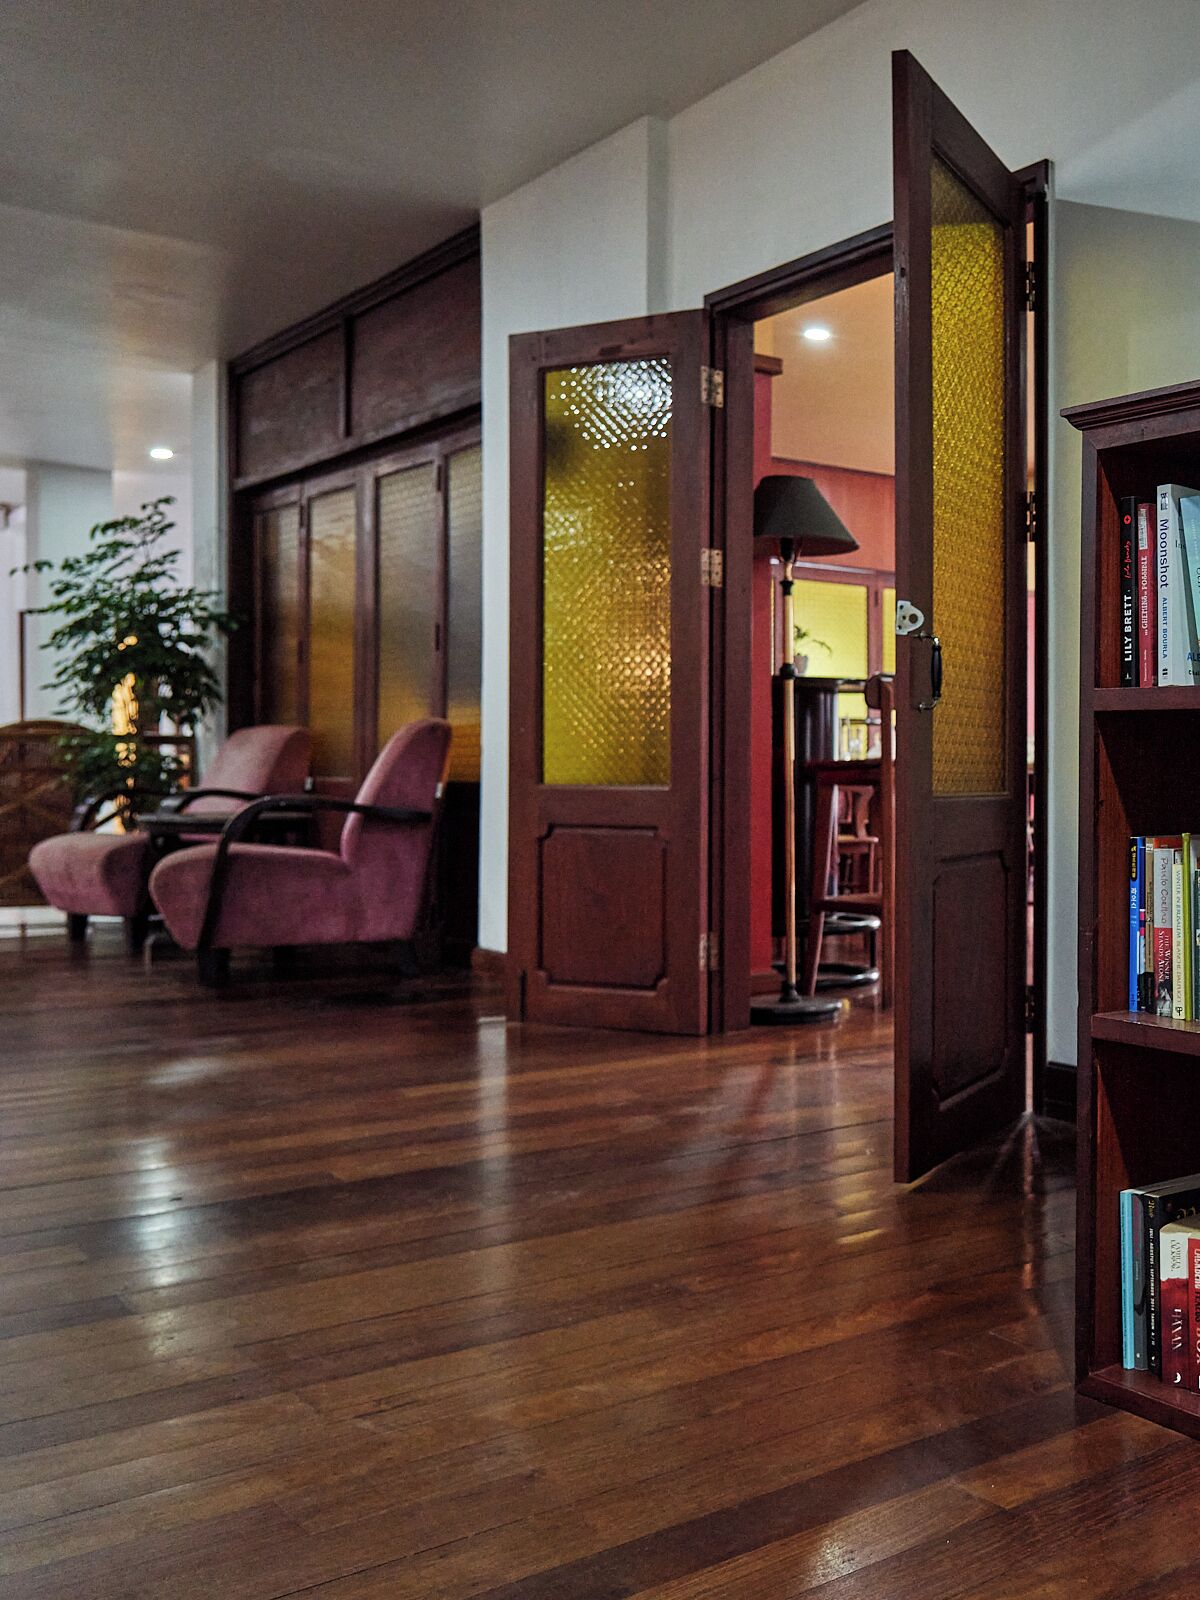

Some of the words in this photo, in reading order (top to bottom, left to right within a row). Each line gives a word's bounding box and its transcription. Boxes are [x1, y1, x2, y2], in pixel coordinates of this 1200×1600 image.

[1159, 519, 1169, 588] Moonshot
[1123, 594, 1133, 633] BRETT
[1123, 634, 1133, 661] LILY
[1160, 857, 1168, 886] Paulo
[1159, 888, 1168, 923] Coelho
